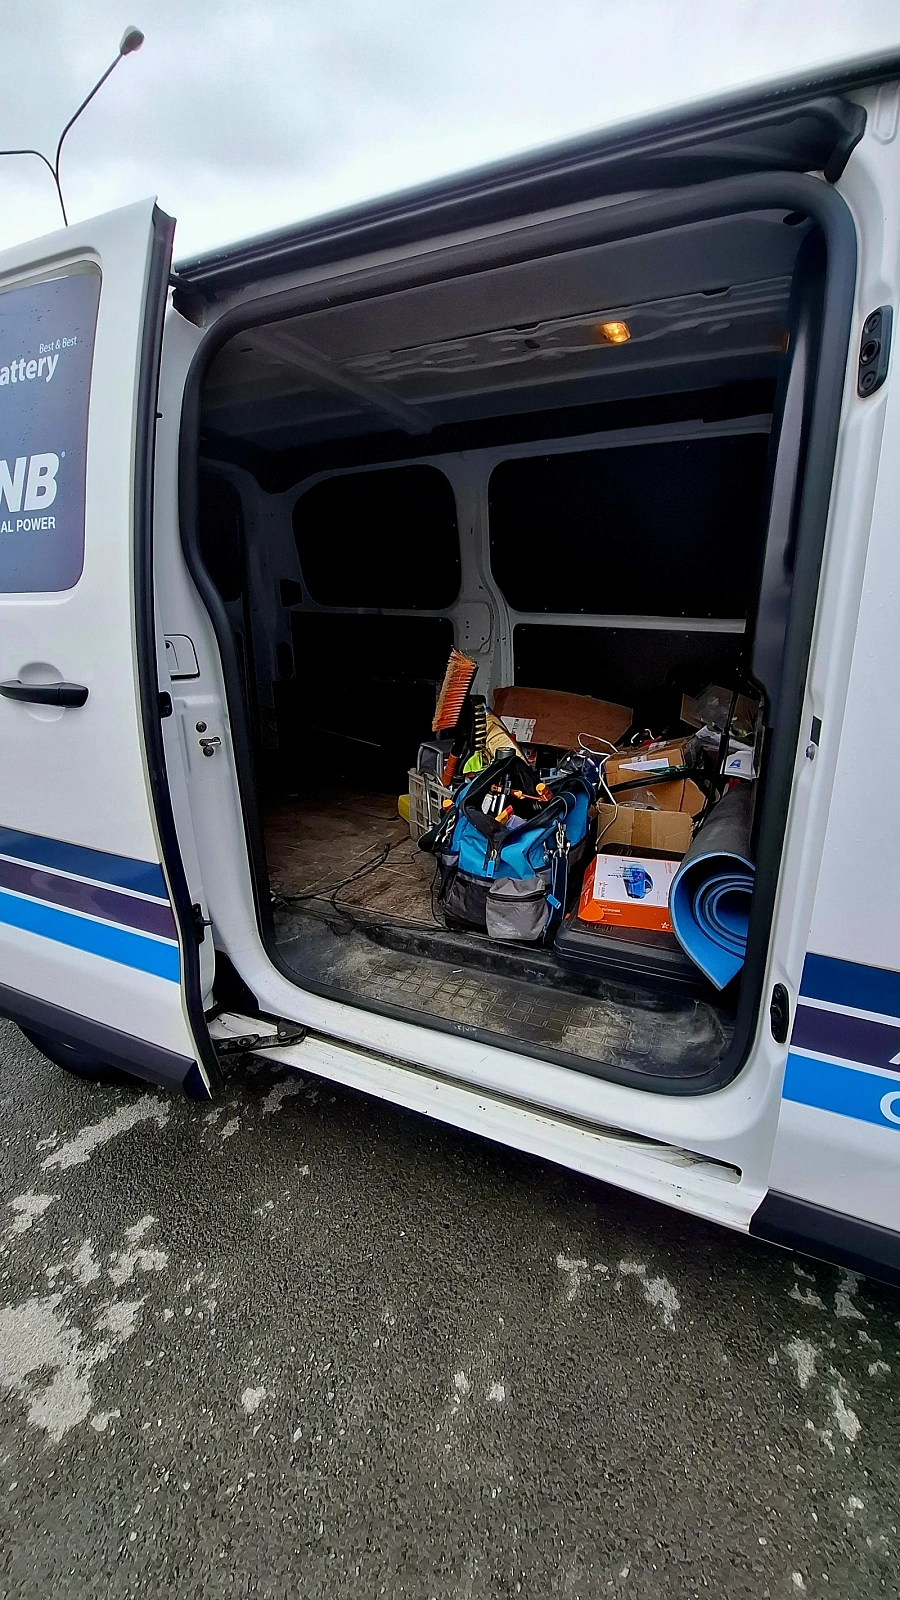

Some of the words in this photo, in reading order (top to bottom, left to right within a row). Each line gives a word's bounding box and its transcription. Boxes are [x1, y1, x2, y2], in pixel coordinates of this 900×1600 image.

[39, 341, 54, 354] Best
[55, 339, 61, 350] &
[62, 335, 77, 348] Best
[16, 516, 56, 532] POWER
